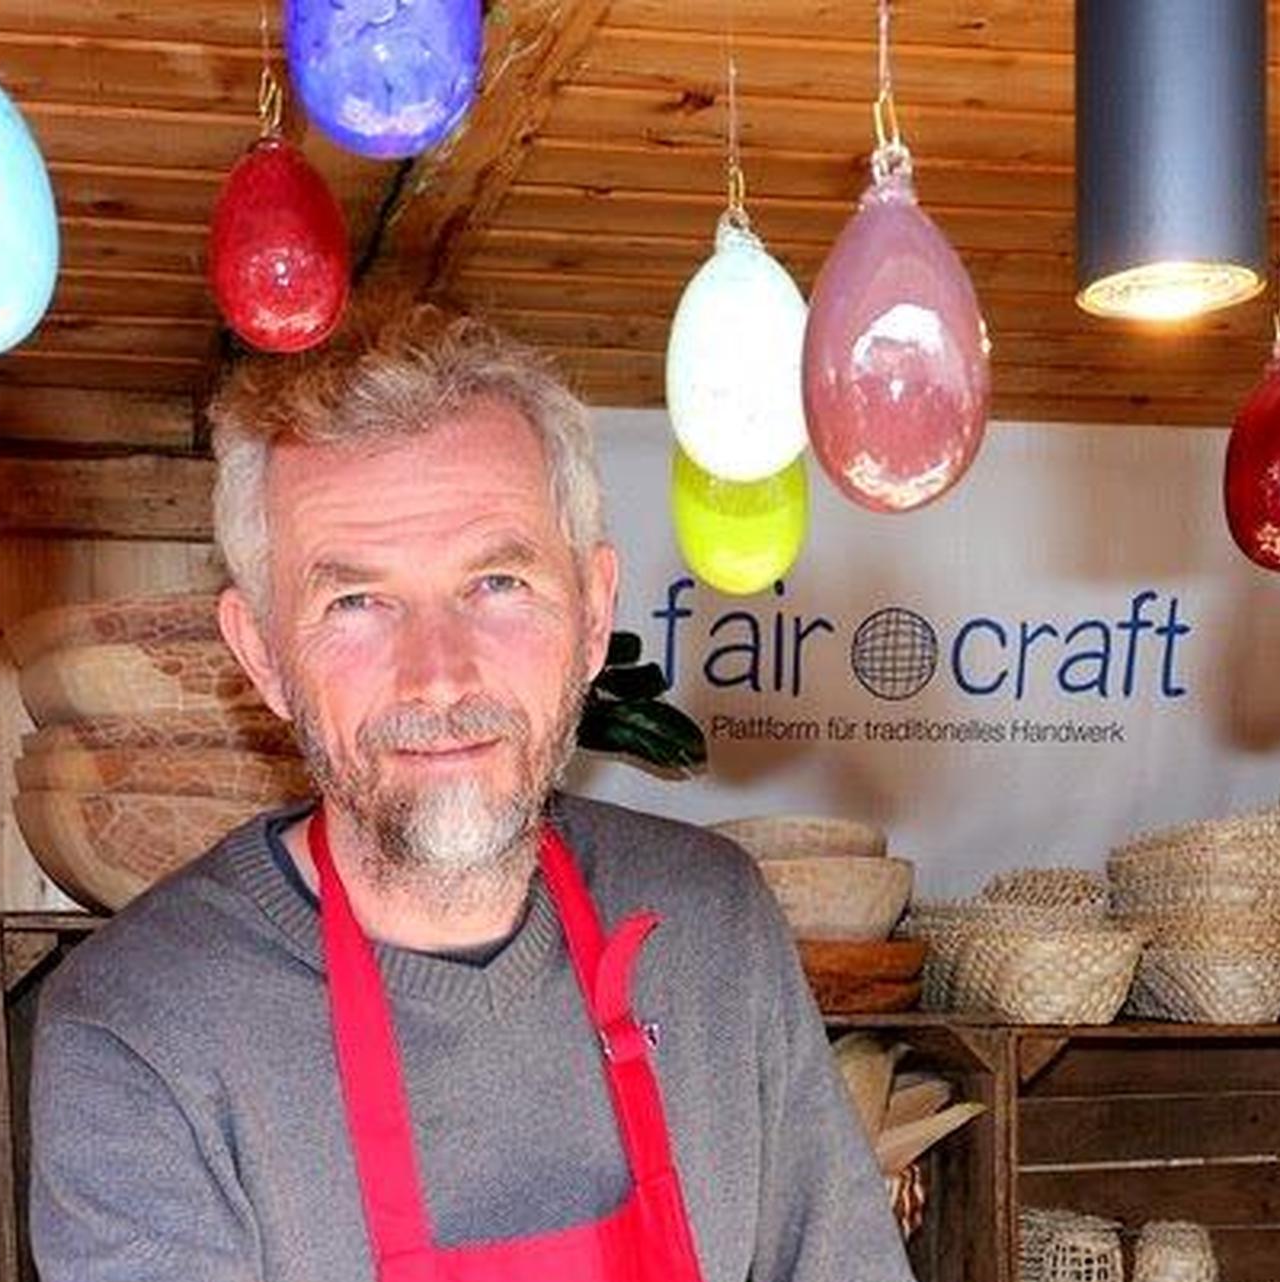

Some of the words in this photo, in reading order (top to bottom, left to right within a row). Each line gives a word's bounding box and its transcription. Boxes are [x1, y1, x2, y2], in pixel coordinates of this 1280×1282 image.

[652, 577, 835, 698] fair
[951, 590, 1191, 700] craft
[711, 716, 819, 742] Plattform
[827, 714, 857, 742] für
[864, 716, 1007, 743] traditionelles
[1009, 717, 1125, 744] Handwerk
